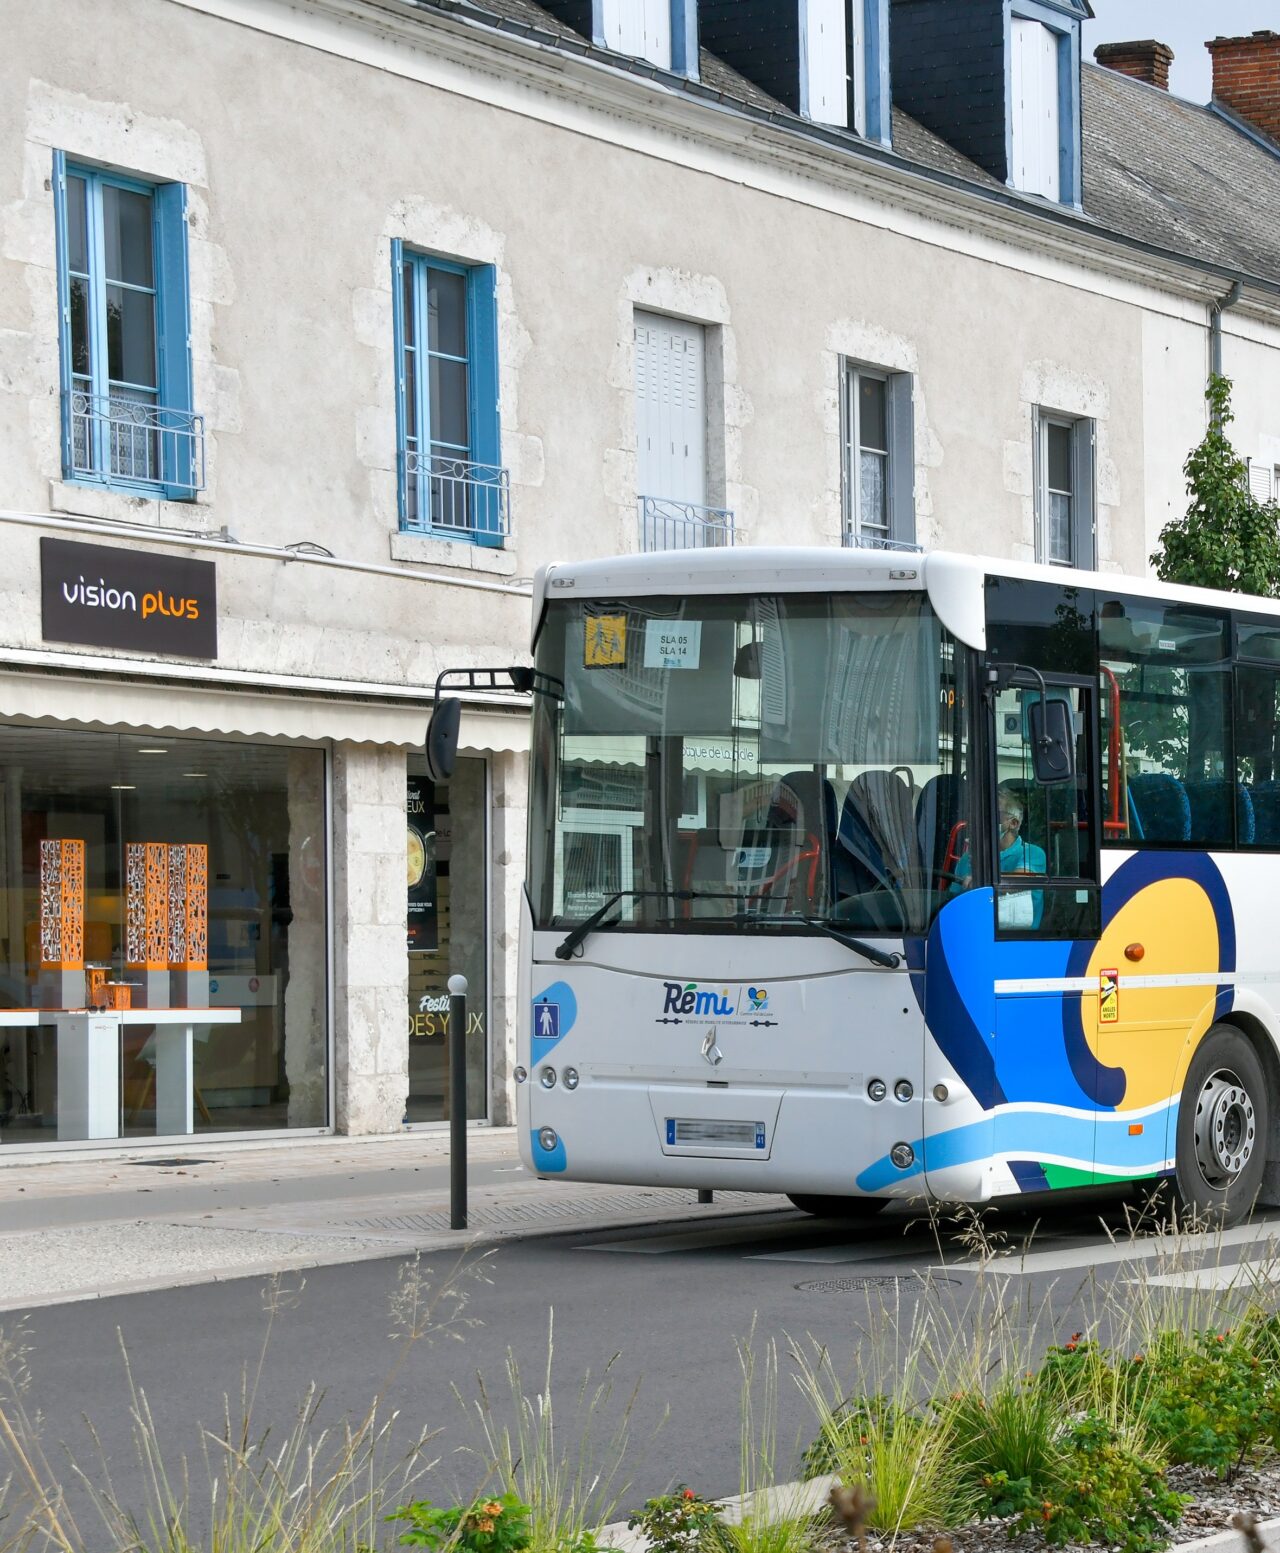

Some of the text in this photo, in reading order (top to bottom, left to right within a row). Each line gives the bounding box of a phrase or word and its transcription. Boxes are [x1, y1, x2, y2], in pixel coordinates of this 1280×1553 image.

[63, 575, 200, 620] vision plus
[661, 635, 688, 645] SLA 05
[660, 646, 687, 655] SLA 14
[419, 994, 451, 1012] Festi
[663, 982, 734, 1016] Rémi
[408, 1013, 436, 1036] DES
[757, 1136, 765, 1145] 41
